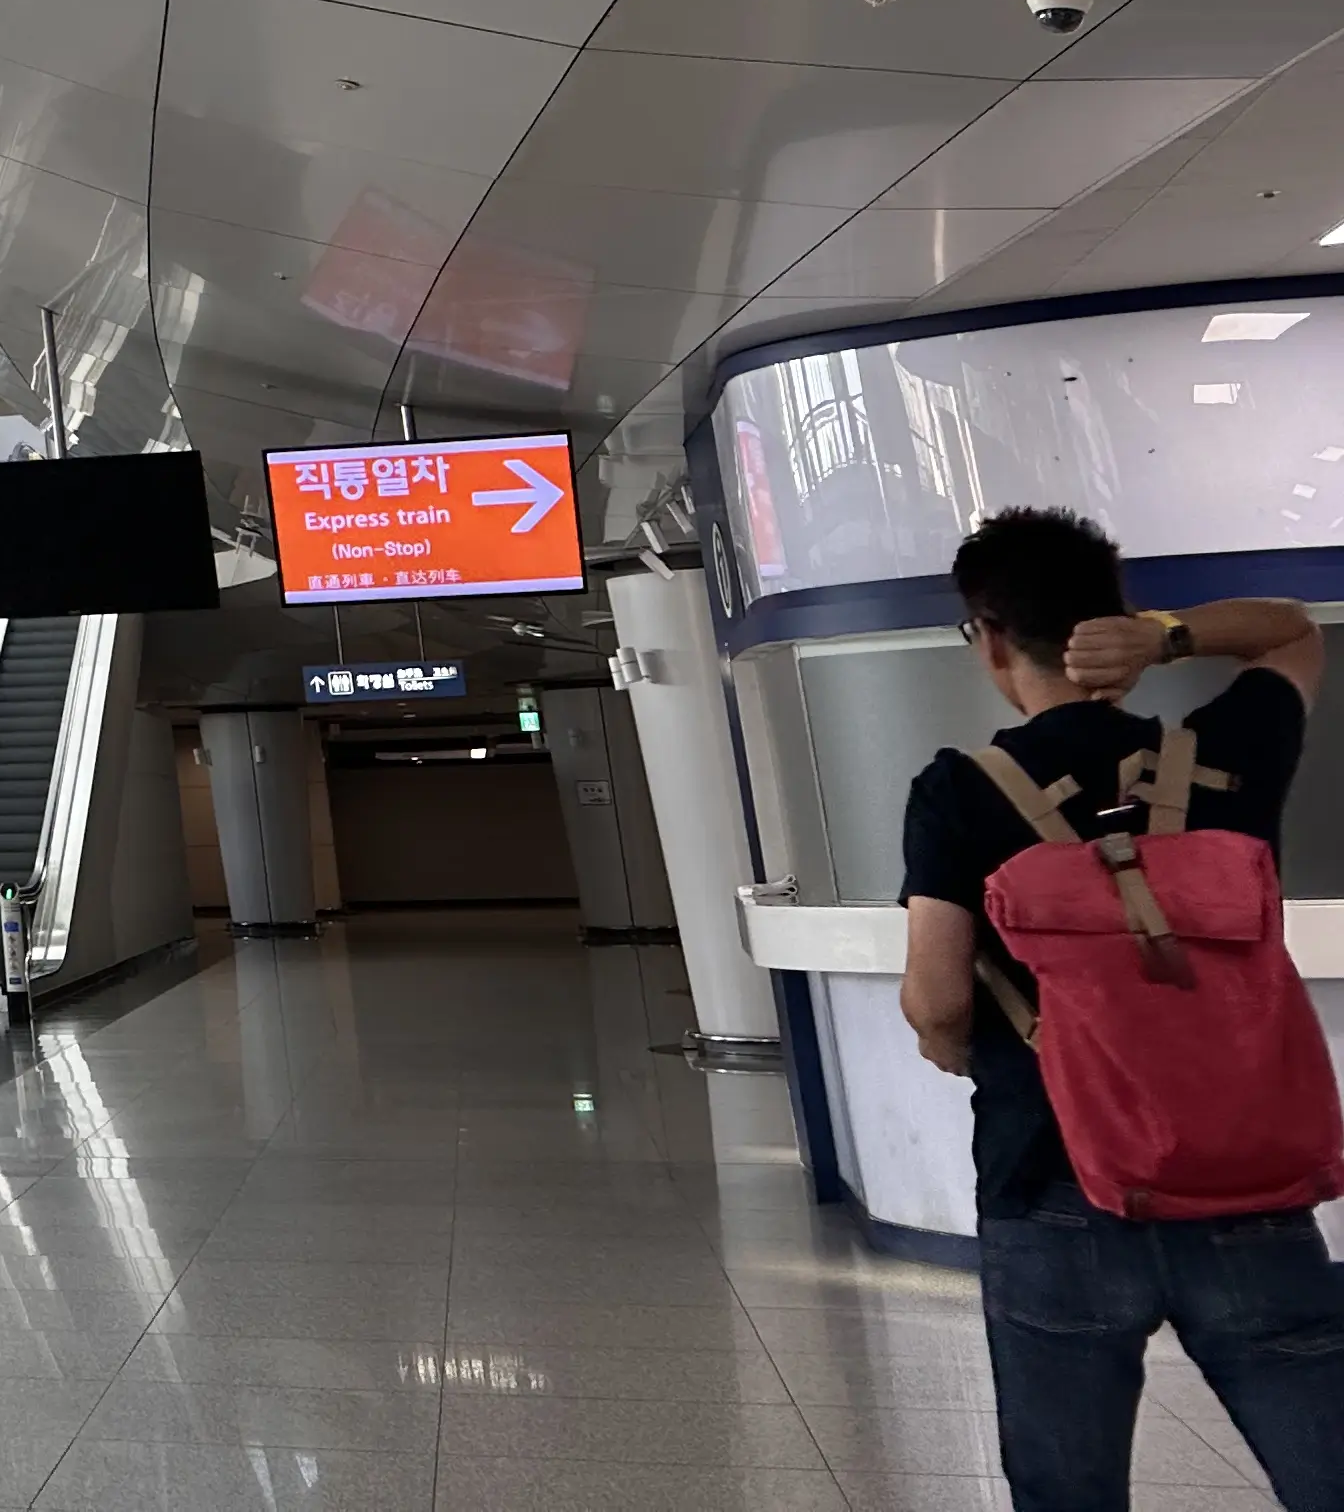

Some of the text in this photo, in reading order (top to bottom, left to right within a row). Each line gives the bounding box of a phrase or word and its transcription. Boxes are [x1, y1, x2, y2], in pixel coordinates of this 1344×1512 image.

[295, 455, 450, 501] 직통열차
[304, 505, 450, 532] Express train
[332, 538, 431, 560] (Non-Stop)
[399, 680, 434, 692] Toilets
